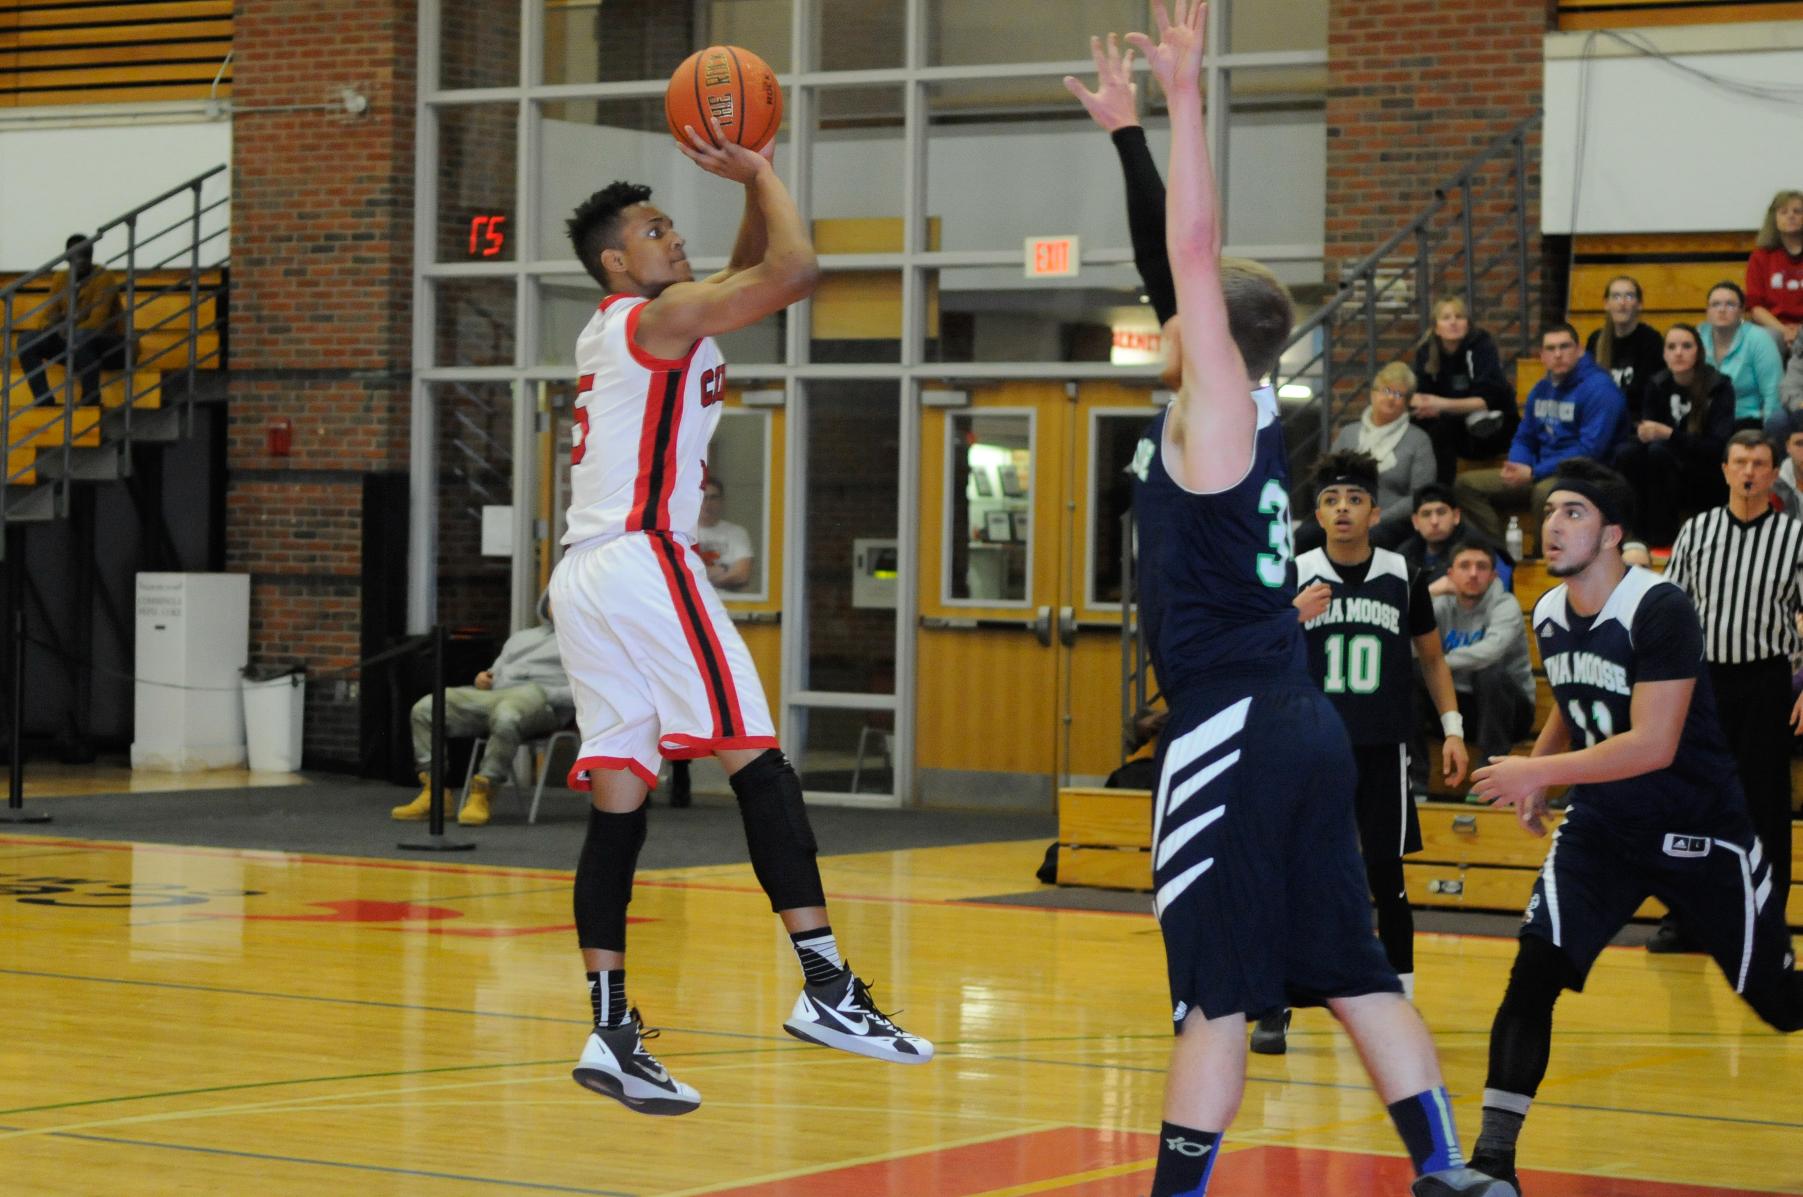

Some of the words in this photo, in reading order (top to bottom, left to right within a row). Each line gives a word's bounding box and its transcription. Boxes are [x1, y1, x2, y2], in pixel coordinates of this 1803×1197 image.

[1034, 239, 1070, 273] EXIT
[1345, 597, 1400, 636] MOOSE
[1323, 633, 1381, 694] 10
[1572, 650, 1631, 696] MOOSE
